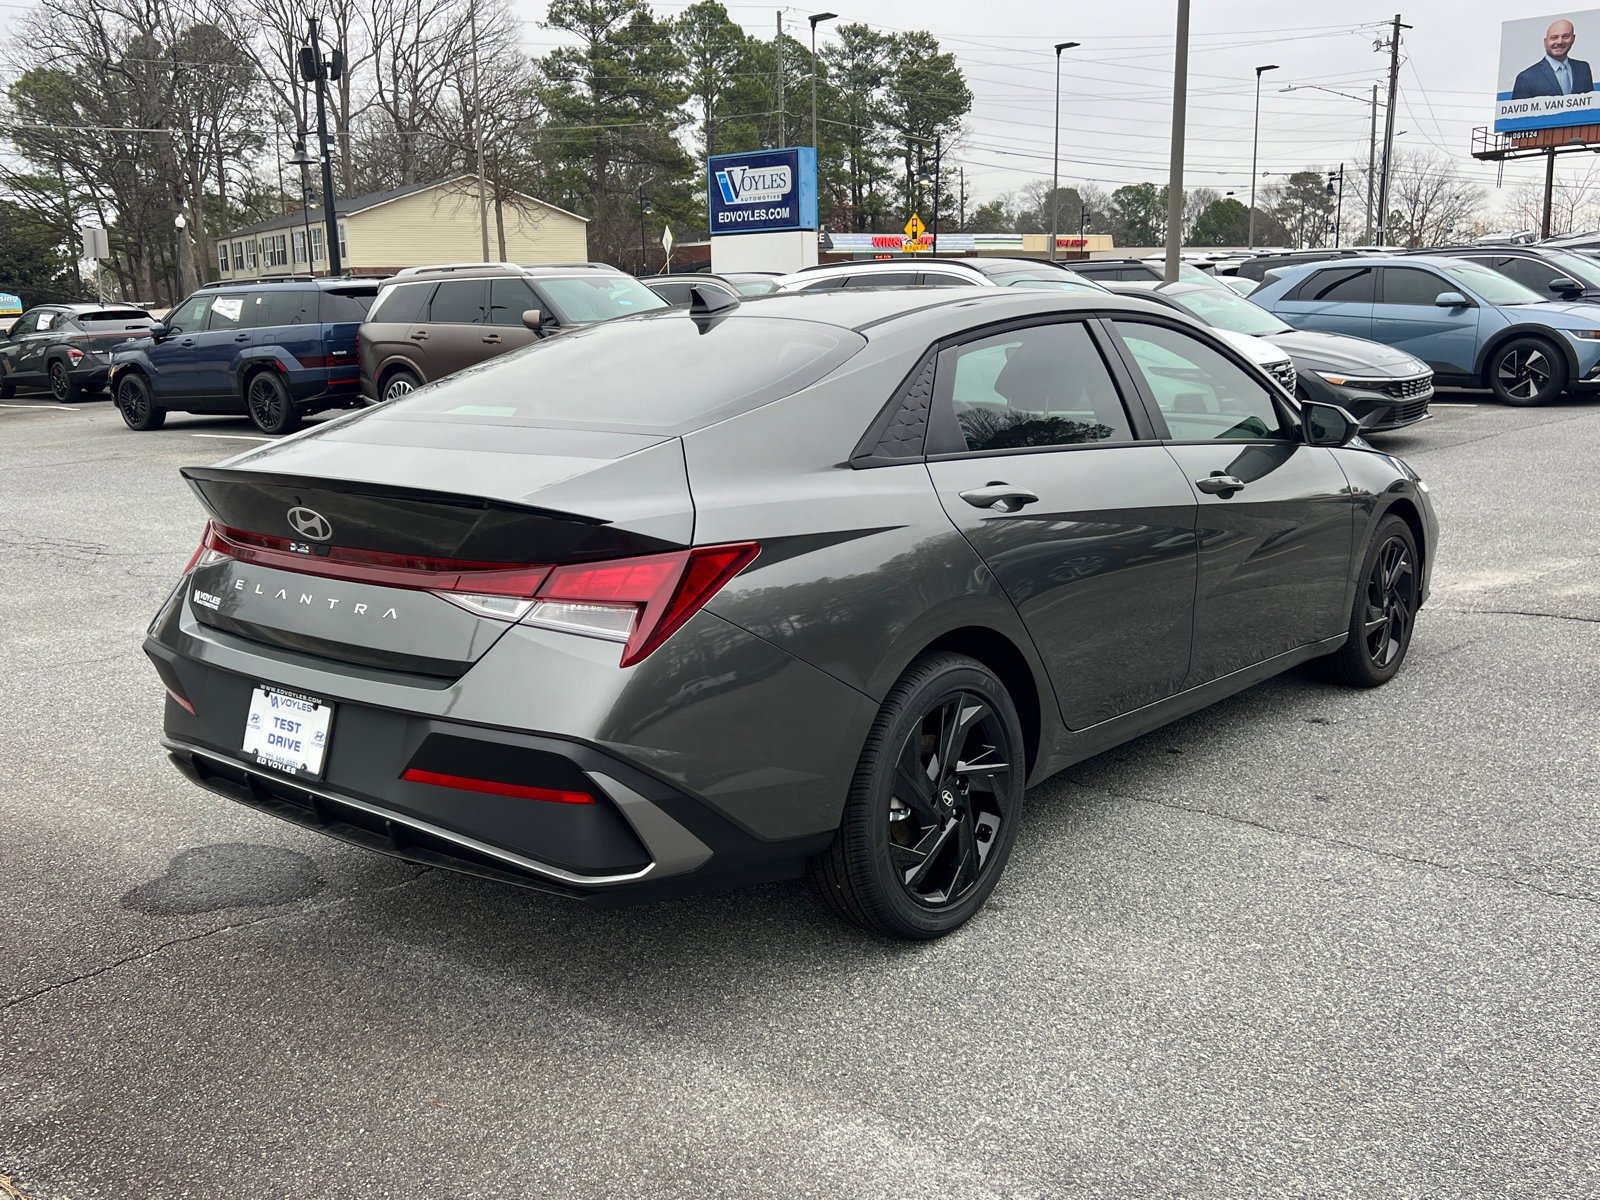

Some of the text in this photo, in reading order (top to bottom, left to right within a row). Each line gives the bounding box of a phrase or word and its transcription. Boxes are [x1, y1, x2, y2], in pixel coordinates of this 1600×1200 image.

[1501, 96, 1593, 115] DAVID M. VAN SANT
[726, 167, 788, 200] VOYLES
[740, 194, 781, 202] AUTOMOTIVE
[718, 207, 790, 223] EDVOYLES.COM
[234, 579, 398, 620] ELANTRA
[260, 684, 322, 705] WWW.EDVOYLES.COM
[280, 697, 313, 713] VOYLES
[273, 716, 302, 734] TEST
[267, 733, 302, 753] DRIVE
[256, 756, 297, 775] ED VOYLES
